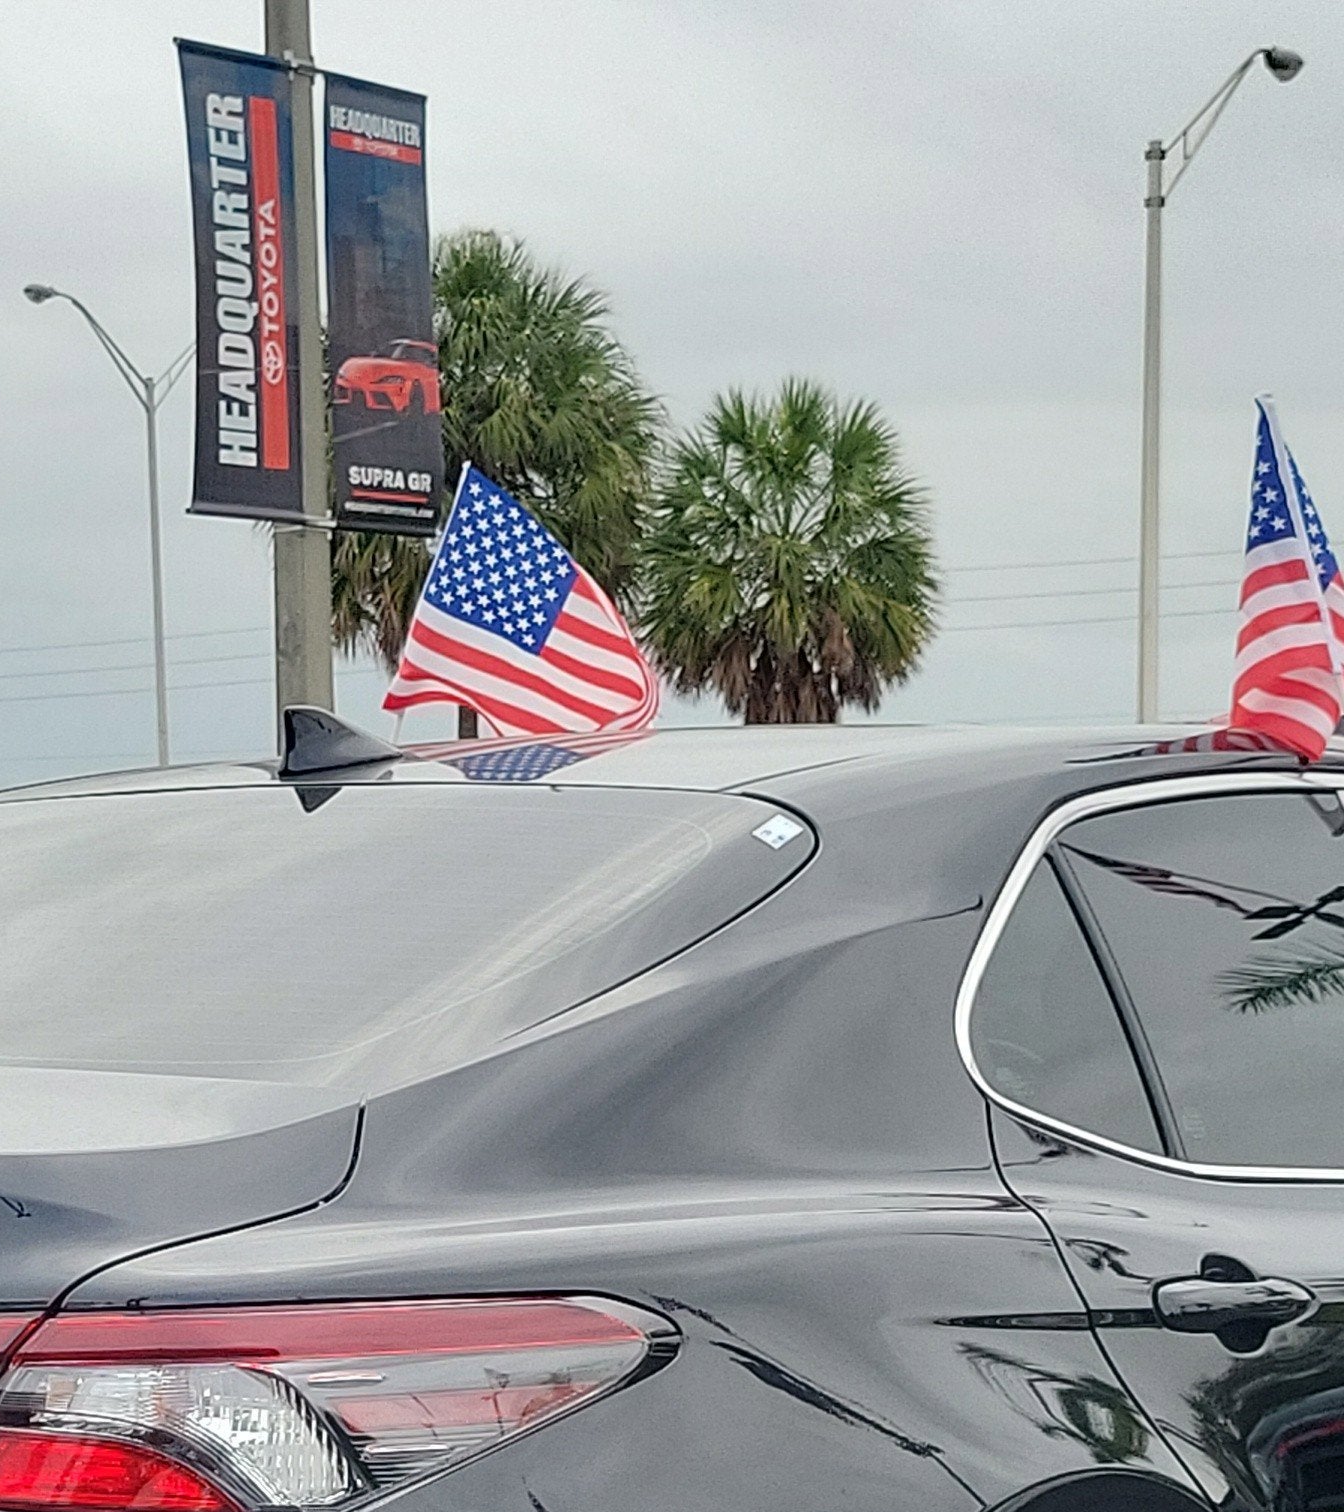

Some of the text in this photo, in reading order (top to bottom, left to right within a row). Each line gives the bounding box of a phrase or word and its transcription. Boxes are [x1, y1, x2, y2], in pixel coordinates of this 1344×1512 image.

[205, 92, 259, 468] HEADQUARTER
[256, 197, 283, 339] TOYOTA
[348, 465, 433, 493] SUPRA GR
